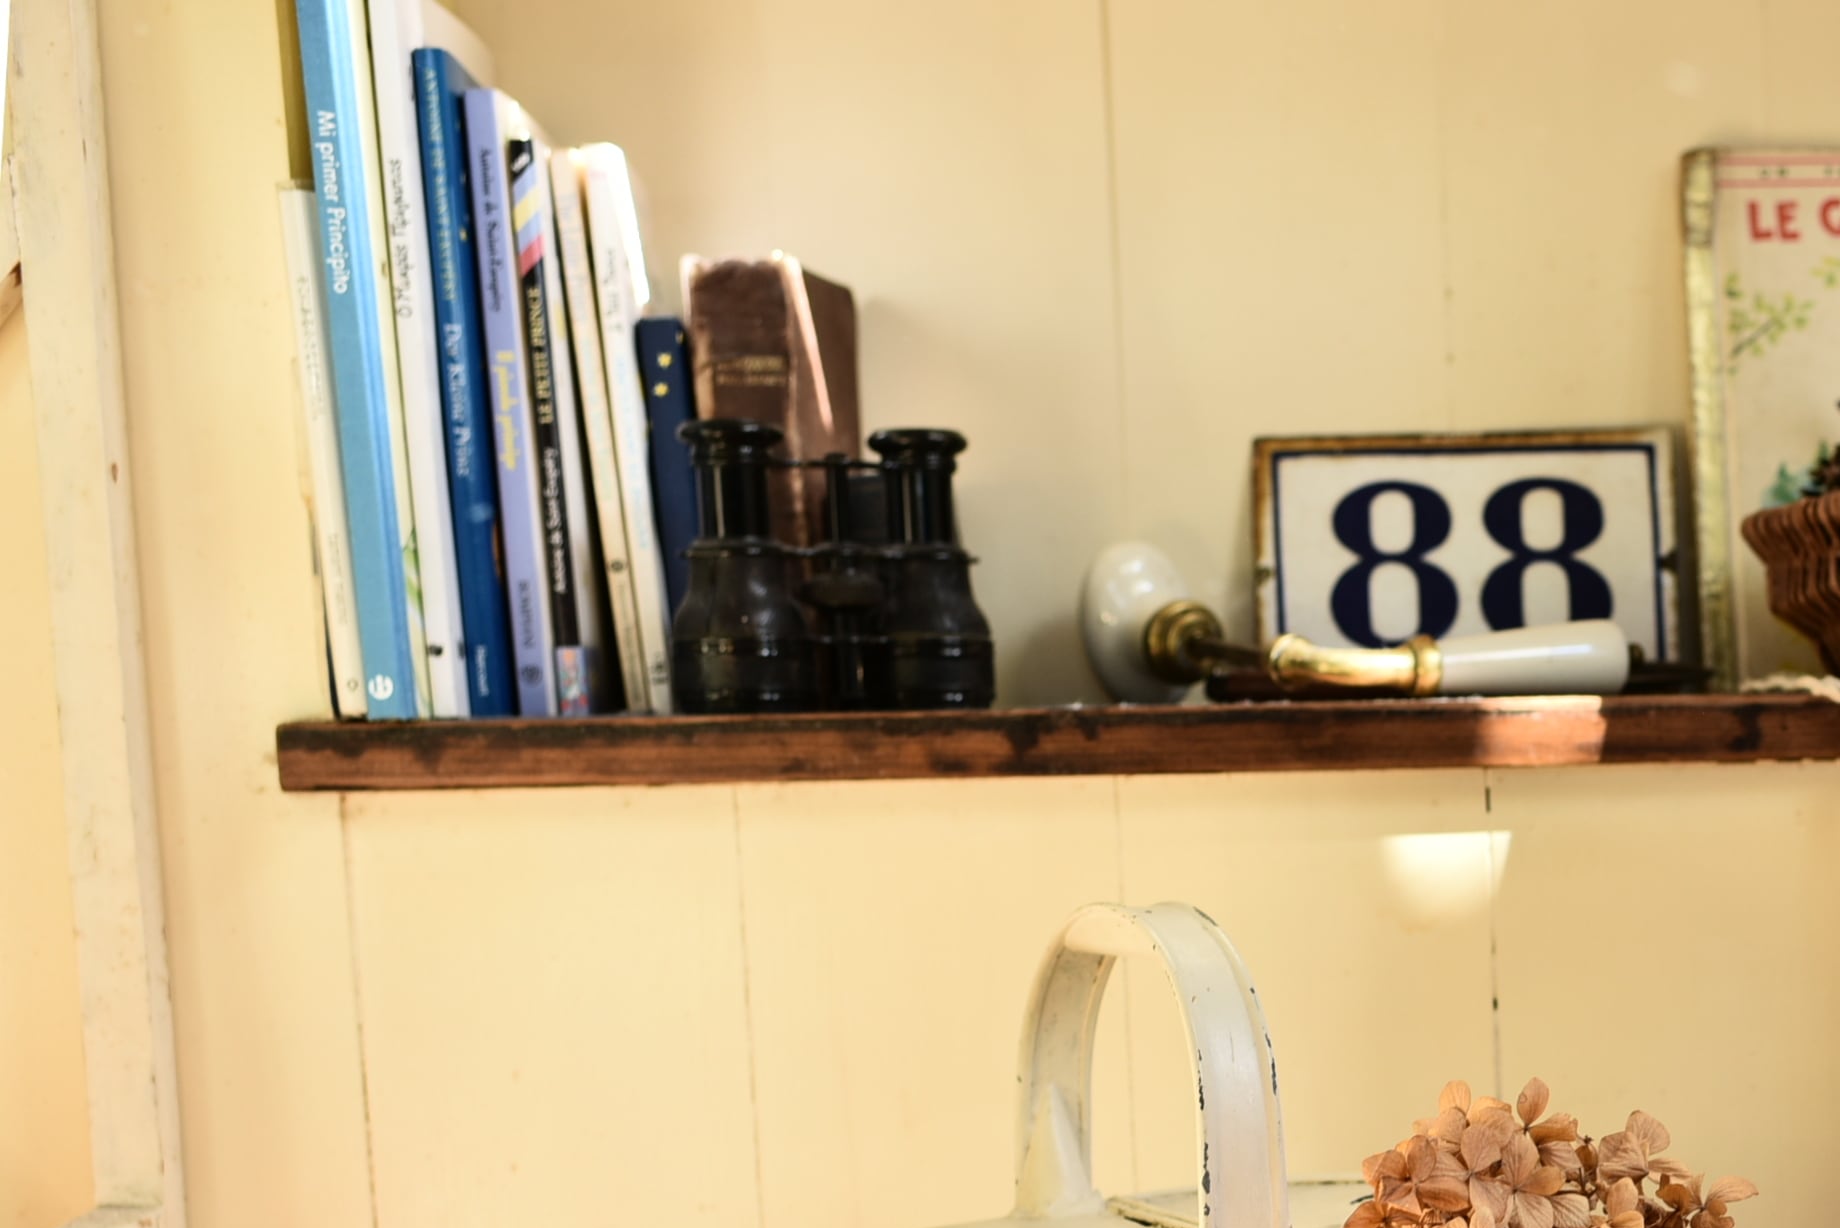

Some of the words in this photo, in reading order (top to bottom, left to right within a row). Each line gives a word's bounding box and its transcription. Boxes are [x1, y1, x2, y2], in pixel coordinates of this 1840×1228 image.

[317, 110, 336, 137] Mi
[315, 142, 341, 202] primer
[1746, 199, 1801, 241] LE
[326, 207, 351, 295] Principito
[443, 322, 463, 357] Der
[527, 286, 546, 347] PRINCE
[533, 351, 552, 400] PETIT
[537, 403, 554, 425] LE
[452, 425, 472, 478] Prinz
[1330, 476, 1614, 649] 88
